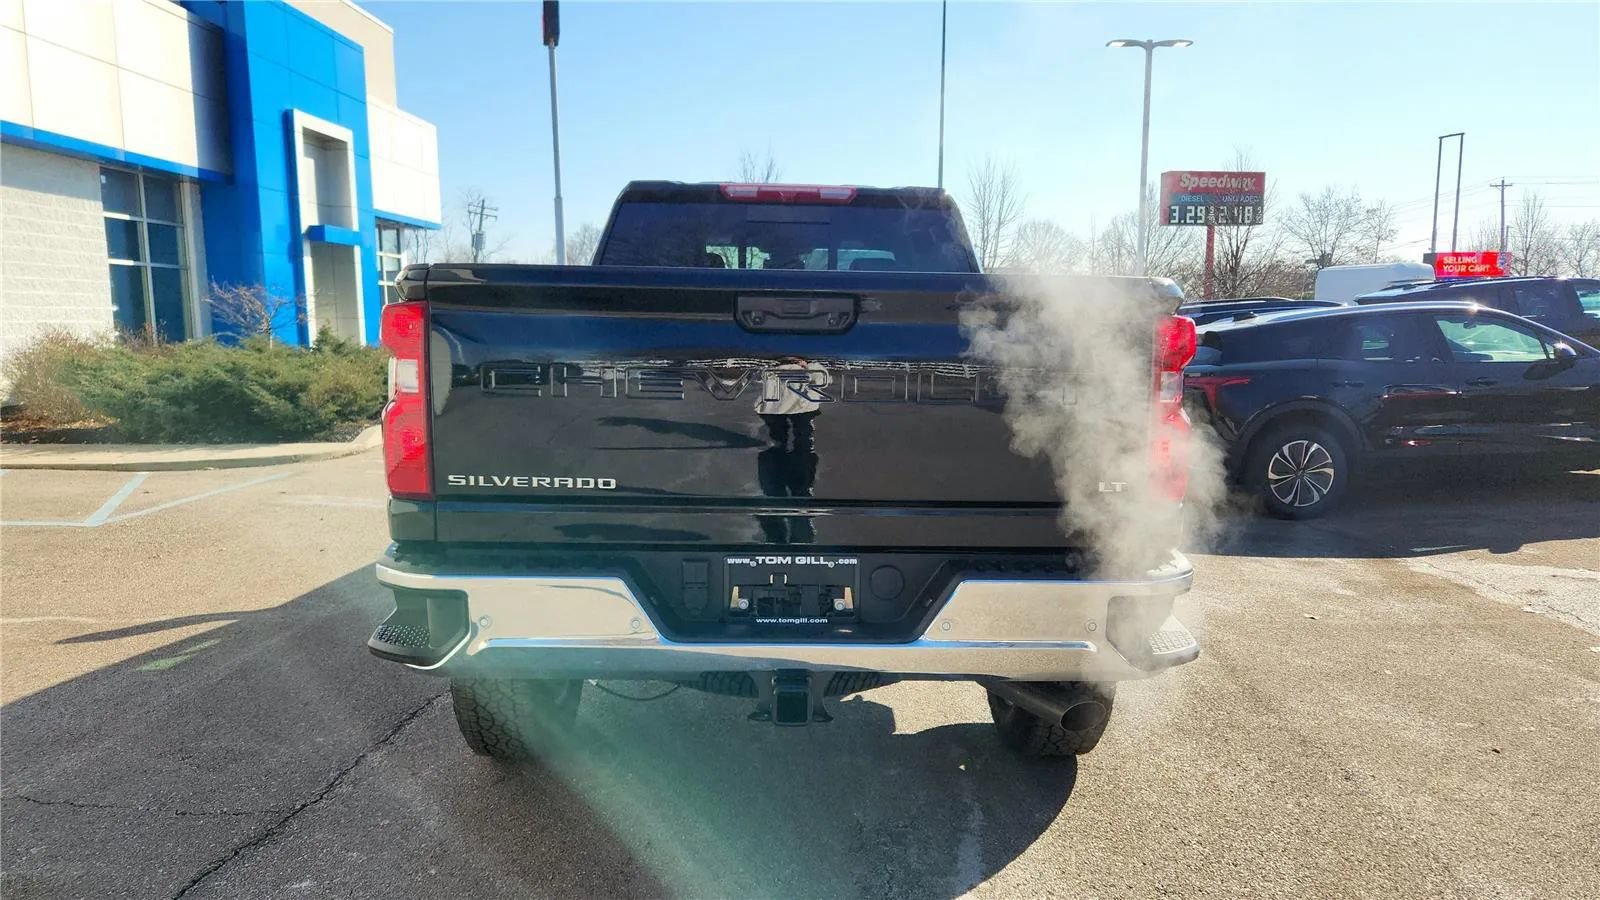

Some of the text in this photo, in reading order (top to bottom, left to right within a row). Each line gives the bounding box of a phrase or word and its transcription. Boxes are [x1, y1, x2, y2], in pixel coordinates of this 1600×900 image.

[1170, 205, 1206, 224] 3.29
[1443, 256, 1477, 264] SELLING
[447, 474, 617, 489] SILVERADO
[1098, 481, 1128, 492] LT
